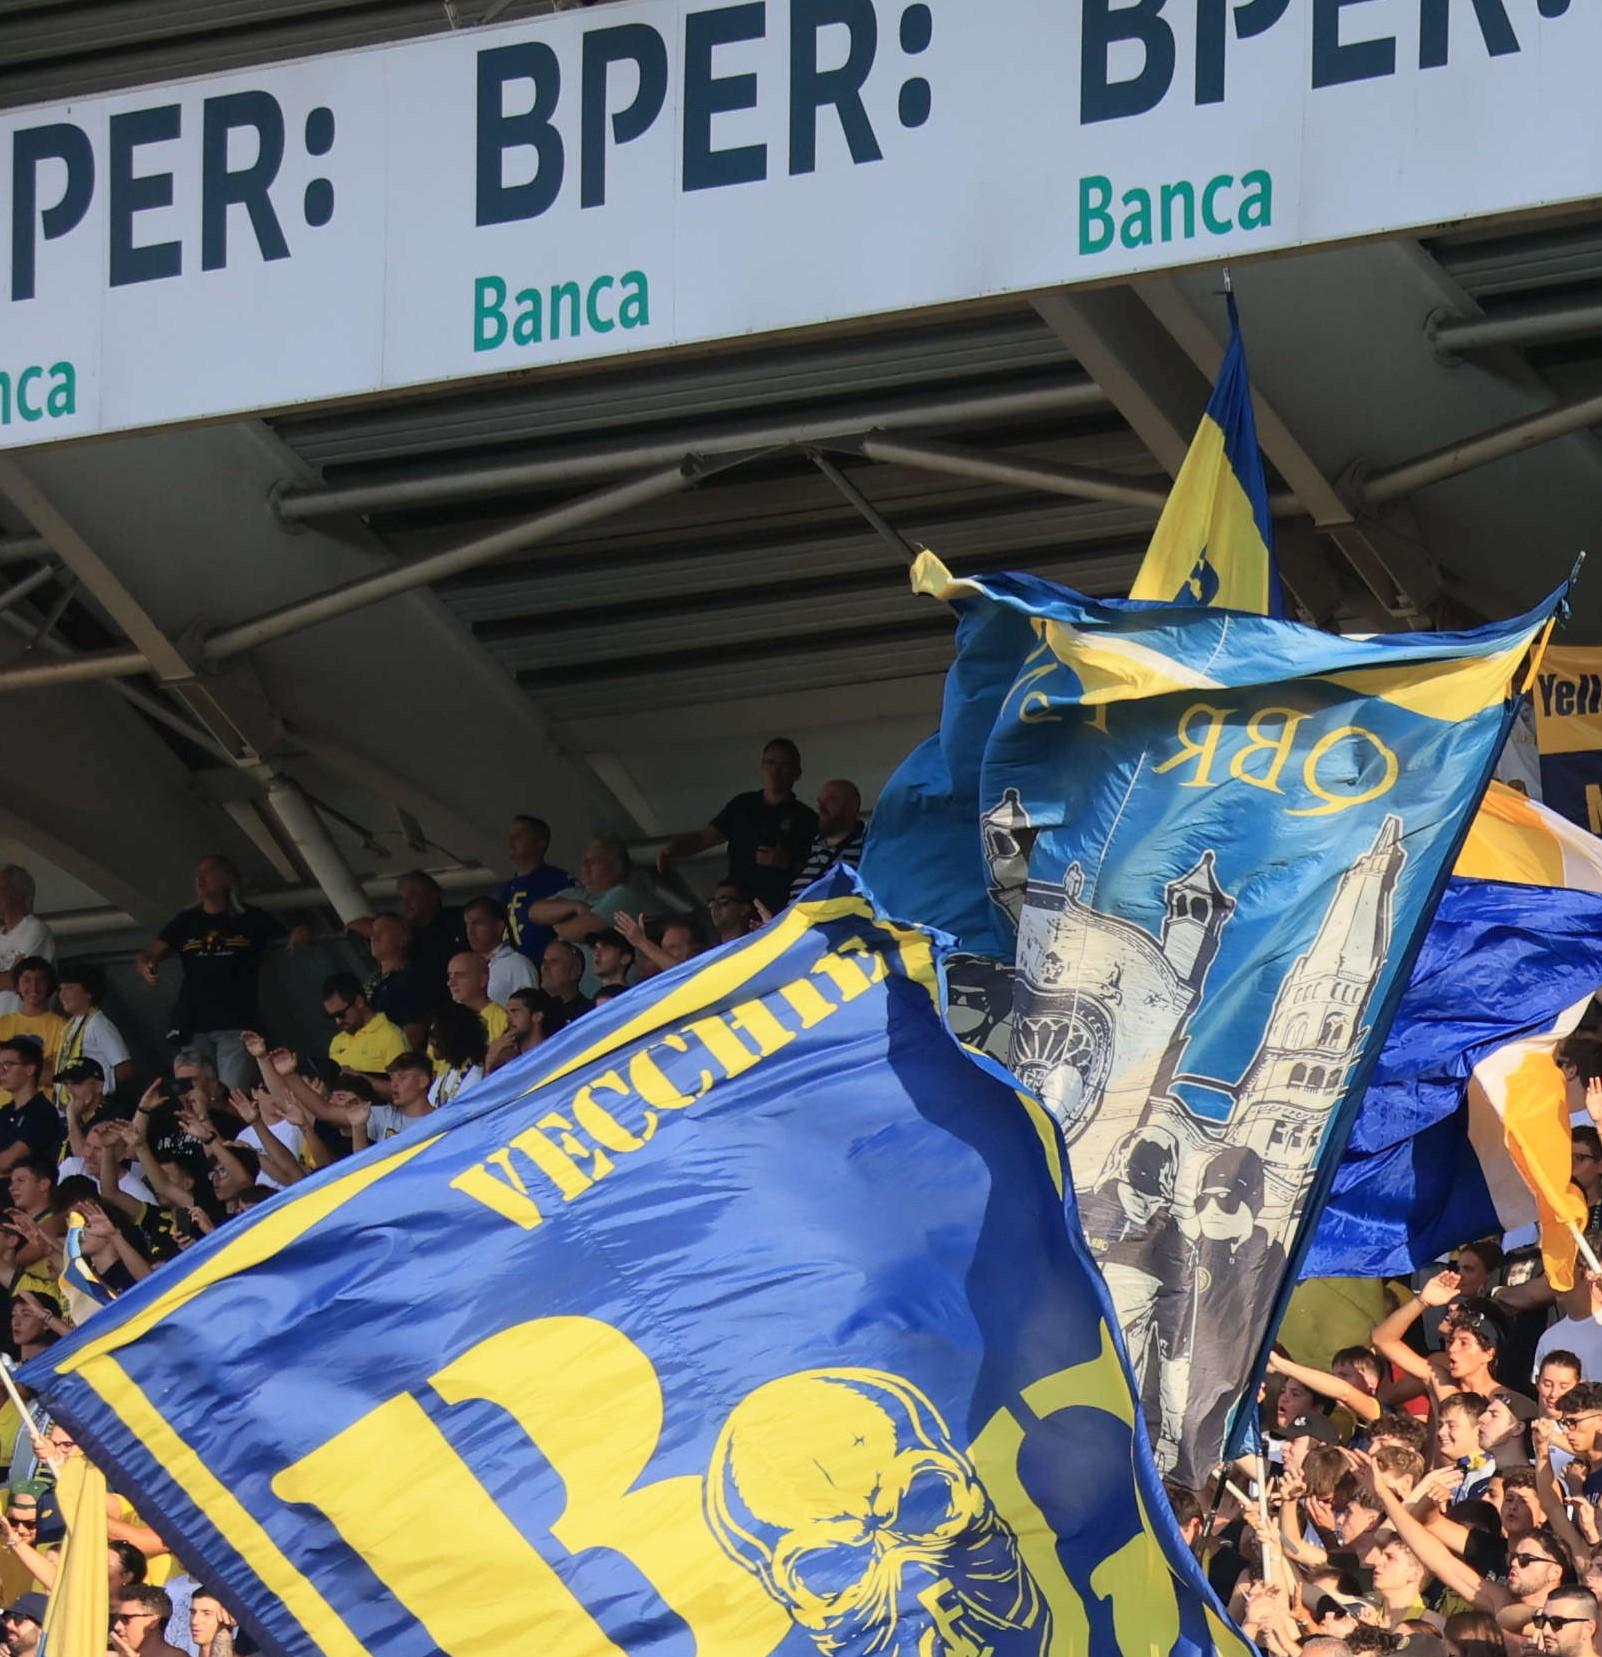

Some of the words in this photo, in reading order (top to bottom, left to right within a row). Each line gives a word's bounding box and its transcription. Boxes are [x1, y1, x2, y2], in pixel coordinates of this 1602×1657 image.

[475, 2, 933, 227] BPER:
[10, 88, 336, 302] PER:
[1079, 168, 1272, 256] Banca
[475, 268, 649, 352] Banca
[0, 361, 77, 424] nca
[450, 934, 891, 1231] VECCHIE
